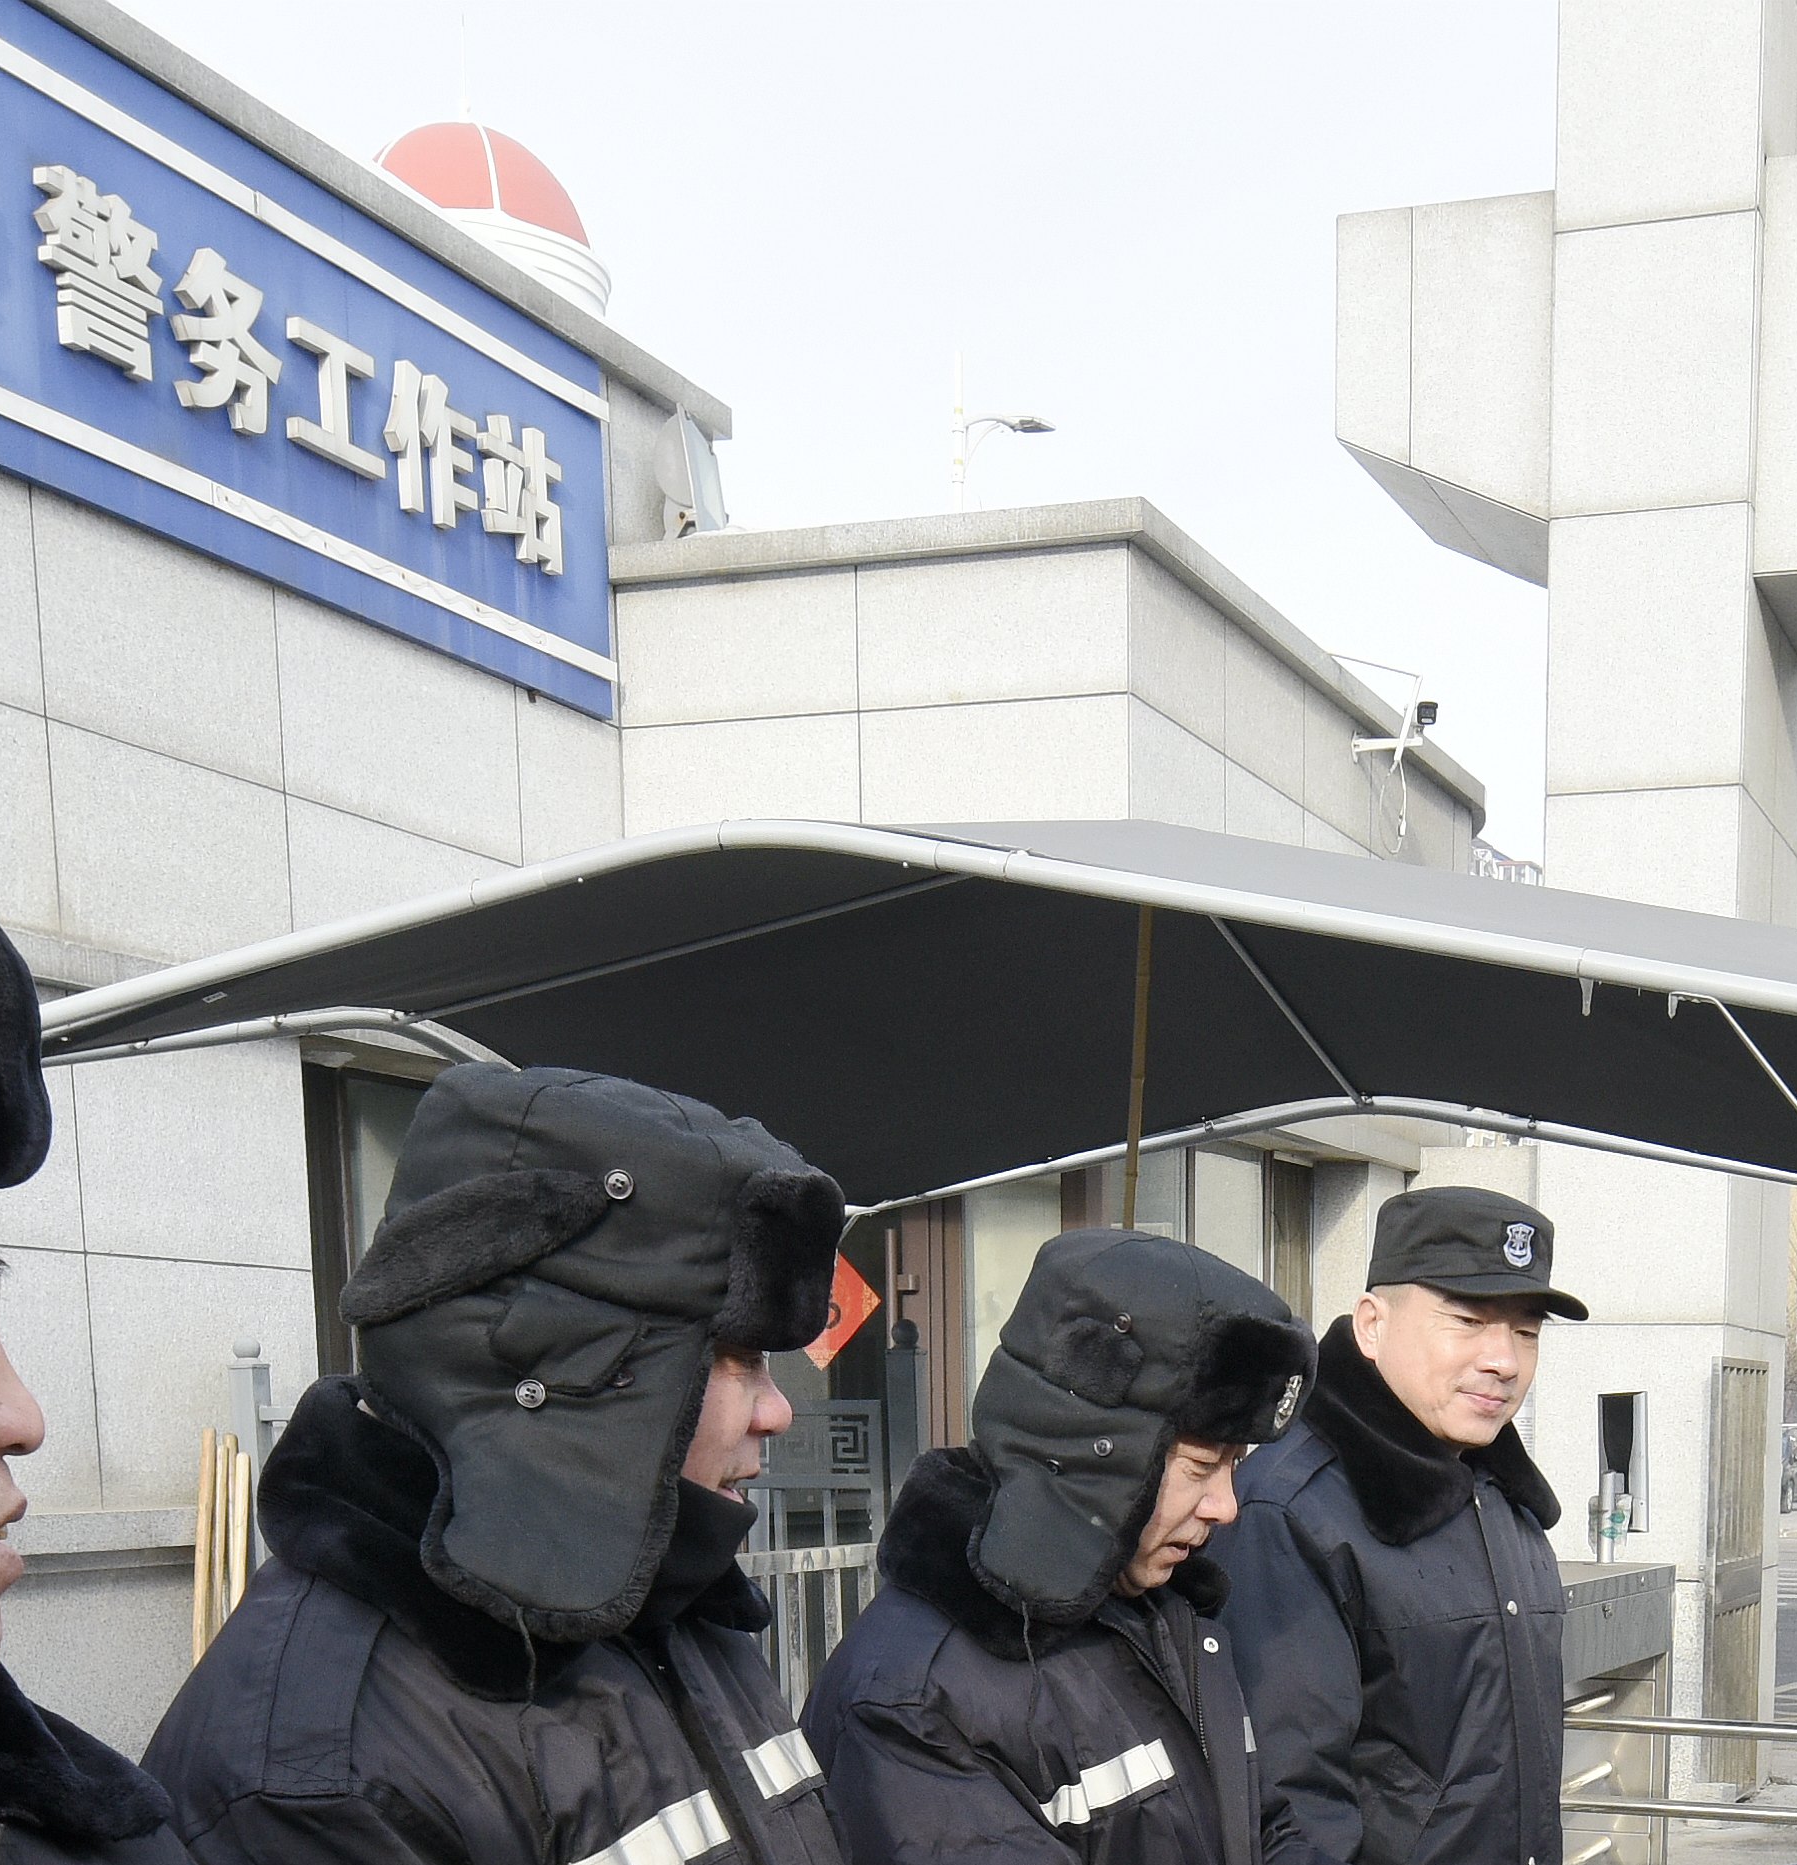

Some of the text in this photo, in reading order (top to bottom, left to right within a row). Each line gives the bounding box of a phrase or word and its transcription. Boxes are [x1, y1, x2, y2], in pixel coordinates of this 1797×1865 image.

[32, 164, 563, 577] 警务工作站
